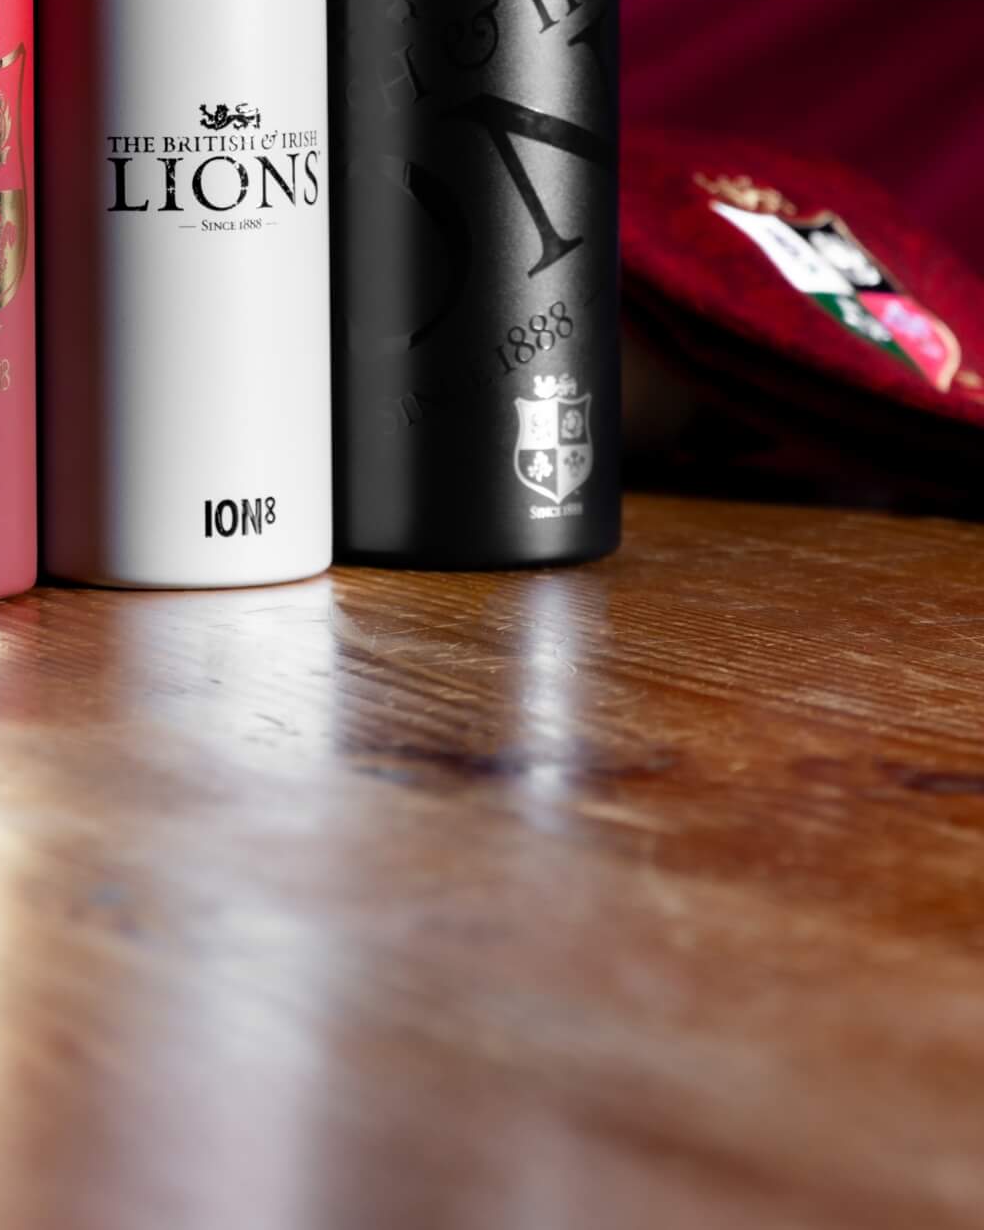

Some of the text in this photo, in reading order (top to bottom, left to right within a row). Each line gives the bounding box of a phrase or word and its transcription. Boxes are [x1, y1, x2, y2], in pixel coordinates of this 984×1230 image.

[107, 130, 318, 153] THE BRITISH & IRISH
[107, 150, 319, 212] LIONS
[239, 218, 263, 231] 1888
[204, 496, 276, 538] ION8
